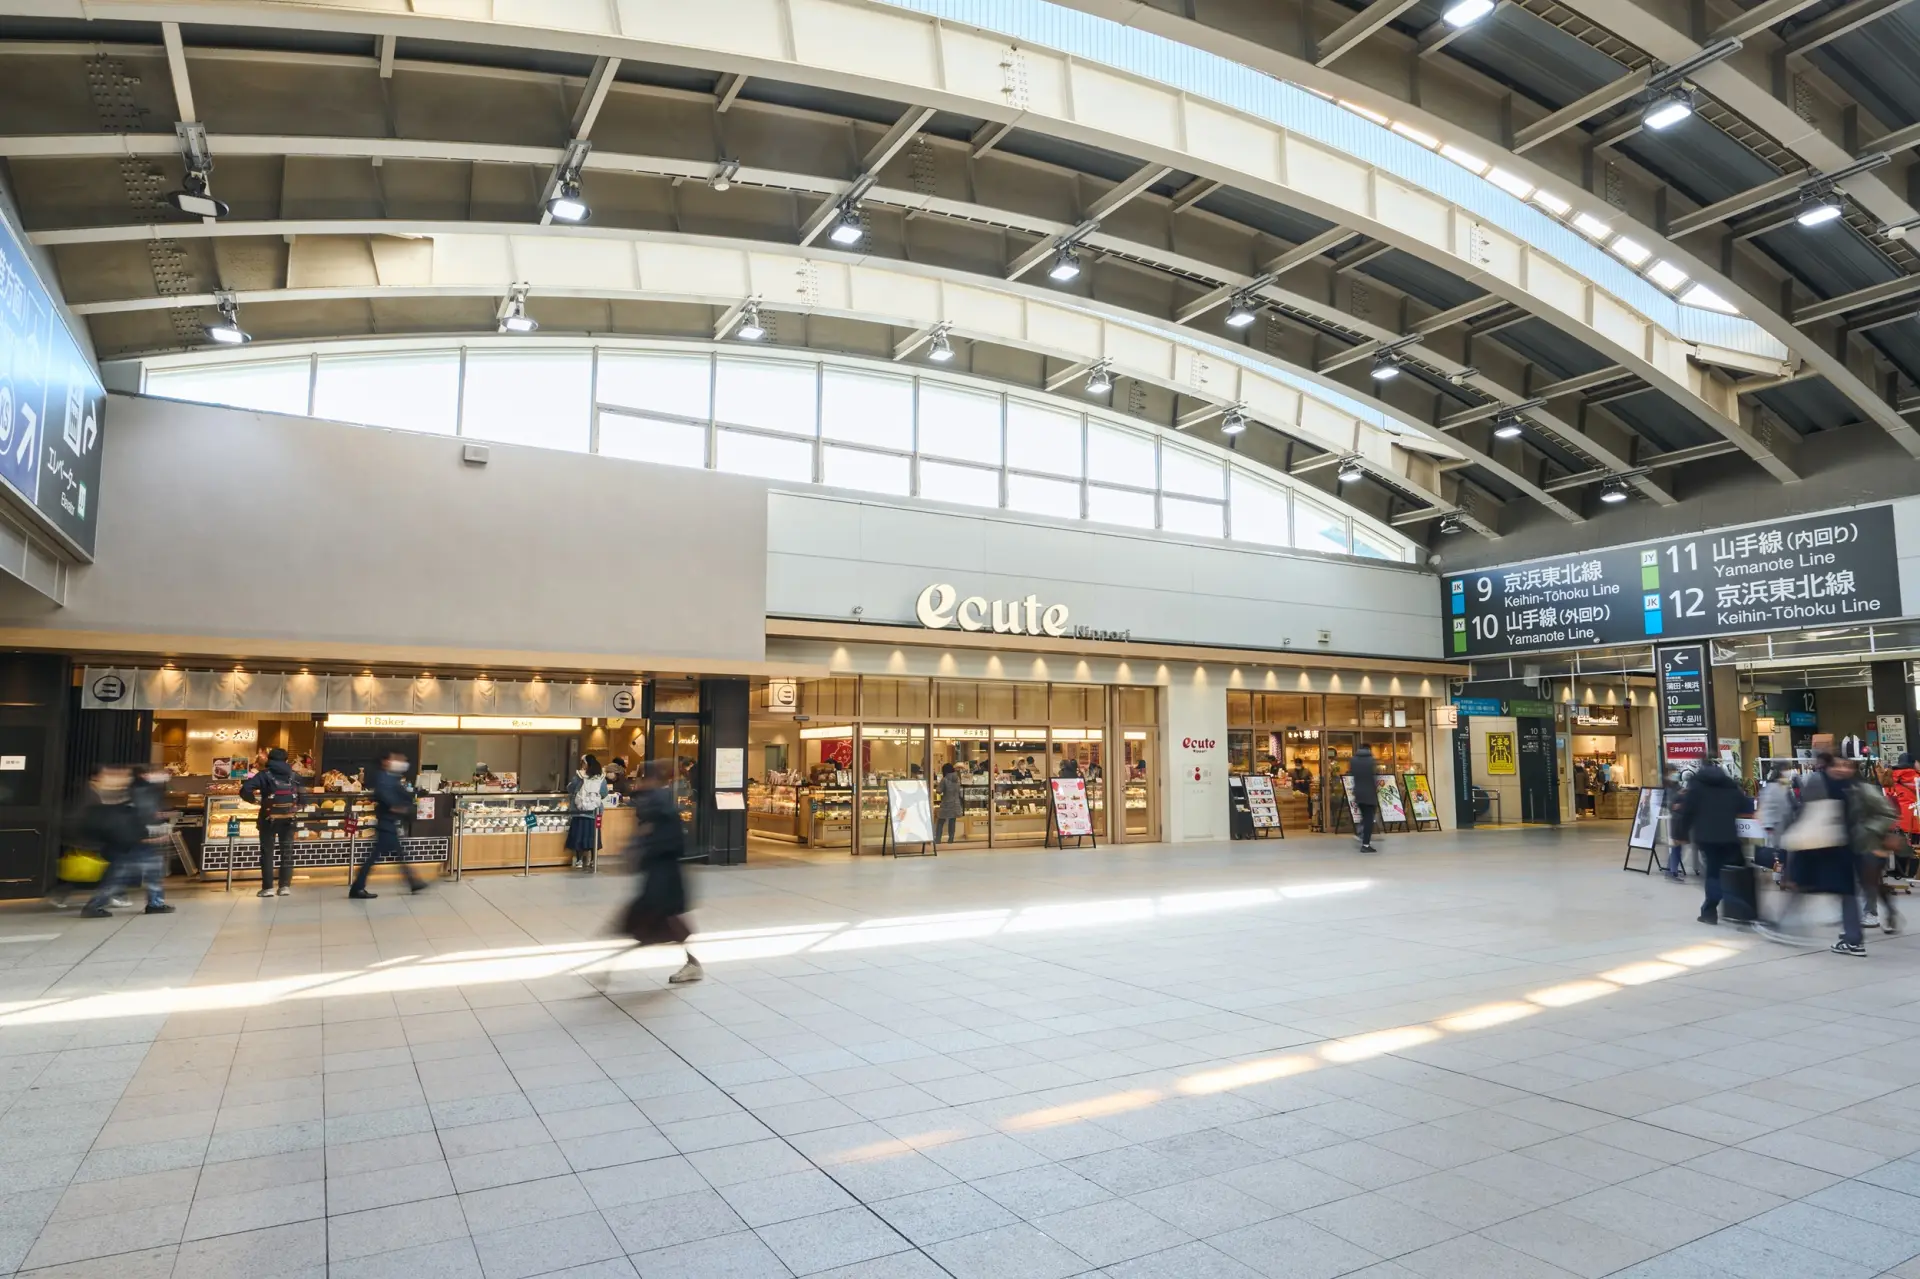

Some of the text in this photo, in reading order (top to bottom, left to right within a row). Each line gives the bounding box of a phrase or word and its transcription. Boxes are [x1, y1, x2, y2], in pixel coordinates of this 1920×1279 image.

[47, 446, 77, 490] エレベーター
[60, 491, 76, 517] Elevator
[1712, 522, 1859, 562] 山手線(内回り)
[1644, 554, 1655, 563] JY
[1666, 542, 1698, 573] 11
[1713, 550, 1836, 578] Yamanote Line
[1453, 583, 1462, 591] JK
[1477, 576, 1493, 602] 9
[1503, 560, 1604, 593] 京浜東北線
[1715, 569, 1857, 609] 京浜東北線
[1504, 583, 1620, 608] Keihin-Tōhoku Line
[1646, 598, 1658, 608] JK
[1669, 587, 1706, 619] 12
[916, 583, 1131, 641] ecute Nippori
[1505, 604, 1611, 632] 山手線(外回り)
[1717, 597, 1881, 626] Keihin-Tōhoku Line
[1455, 621, 1464, 629] JY
[1471, 613, 1499, 640] 10
[1507, 627, 1595, 646] Yamanote Line
[1665, 662, 1672, 672] 9
[1667, 695, 1679, 705] 10
[1803, 692, 1816, 712] 12
[374, 717, 405, 726] Baker
[1182, 737, 1216, 749] ecute
[1490, 737, 1510, 746] とまる
